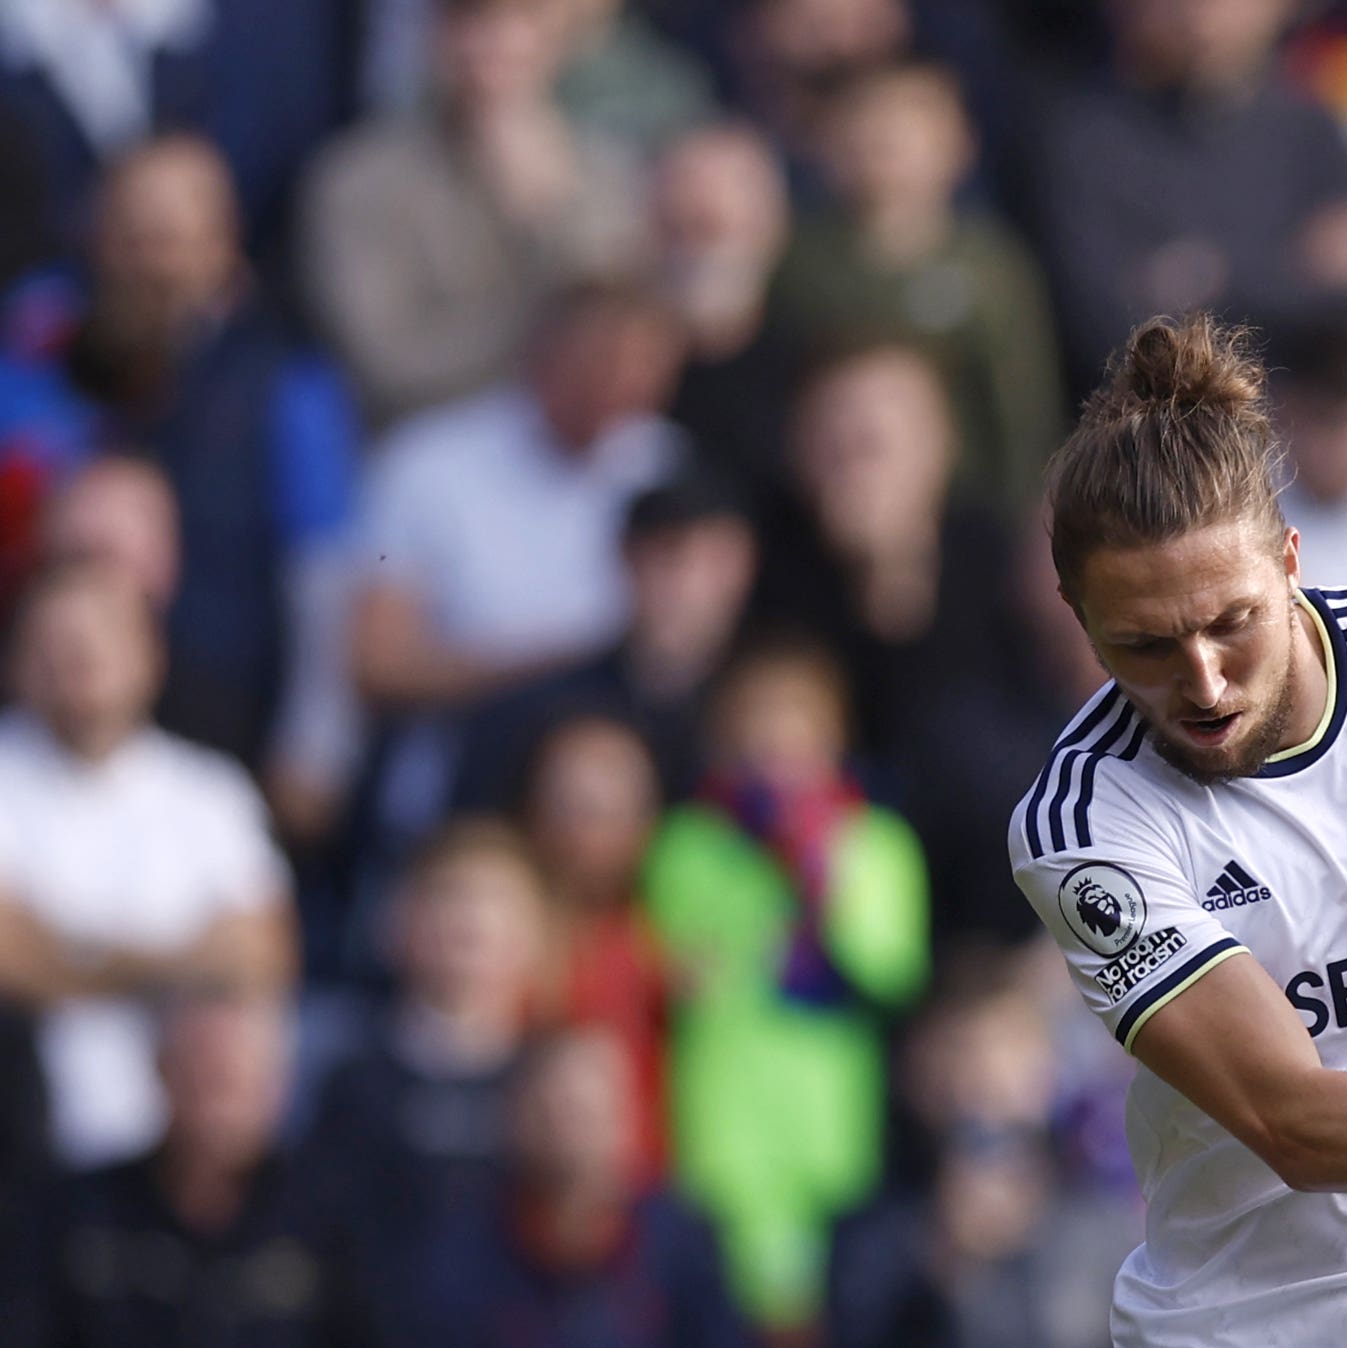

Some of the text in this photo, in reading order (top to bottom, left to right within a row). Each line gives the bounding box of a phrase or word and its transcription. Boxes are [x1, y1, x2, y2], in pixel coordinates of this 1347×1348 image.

[1202, 886, 1272, 912] adidas
[1096, 931, 1172, 991] No room
[1105, 932, 1187, 1006] for racism
